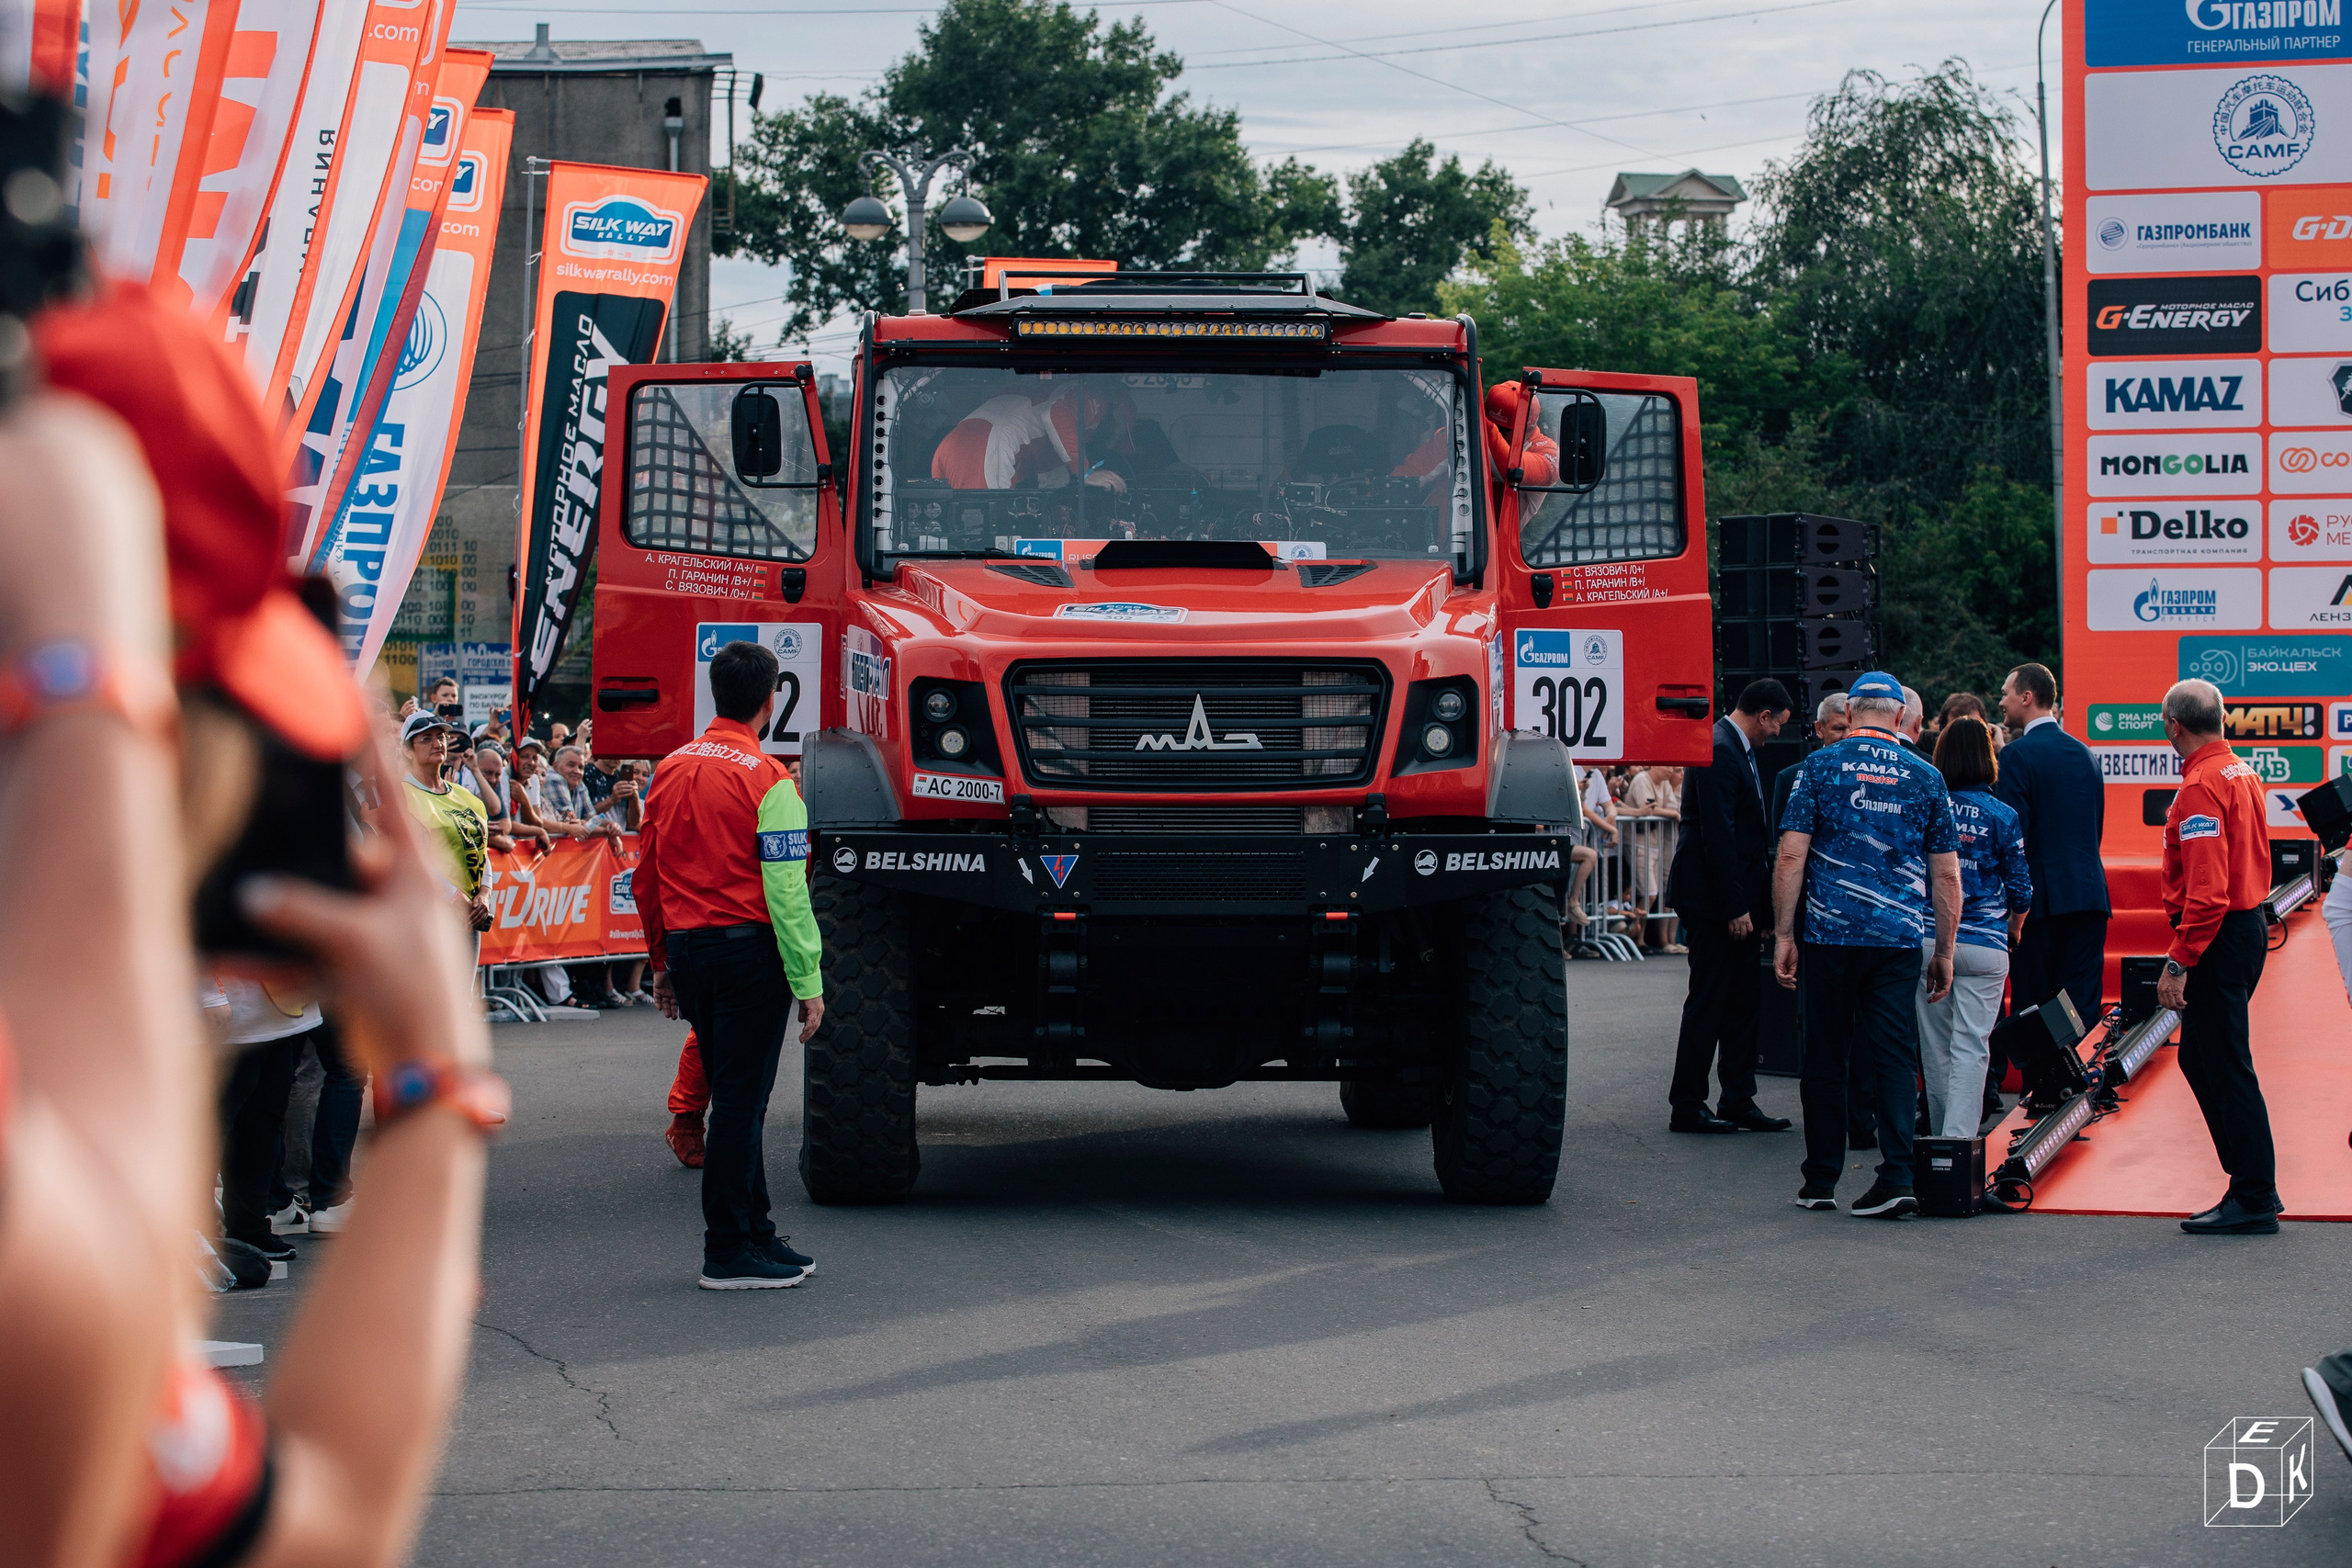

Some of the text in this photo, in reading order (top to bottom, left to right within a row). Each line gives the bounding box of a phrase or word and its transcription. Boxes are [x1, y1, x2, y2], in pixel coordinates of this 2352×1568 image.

[2232, 0, 2341, 29] ГАЗПРОМ
[2188, 35, 2341, 53] ГЕНЕРАЛЬНЫЙ ПАРТНЕР
[2228, 143, 2301, 160] CAMF
[573, 216, 672, 237] SILK WAY
[2137, 222, 2251, 241] ГАЗПРОМБАНК
[597, 231, 646, 243] RALLY
[556, 263, 673, 287] silkwayrally.com
[2295, 279, 2350, 302] Сиб
[2160, 301, 2255, 310] МОТОРНОЕ МАСЛО
[2105, 376, 2244, 413] KAMAZ
[2100, 454, 2249, 476] MONGOLIA
[2129, 510, 2249, 539] Delko
[645, 553, 655, 563] А.
[658, 554, 732, 571] КРАГЕЛЬСКИЙ
[668, 569, 678, 580] П.
[681, 570, 729, 585] ГАРАНИН
[1573, 567, 1583, 578] С.
[1585, 564, 1628, 577] ВЯЗОВИЧ
[665, 580, 675, 591] С.
[678, 582, 729, 597] ВЯЗОВИЧ
[1575, 581, 1585, 591] П.
[1586, 578, 1628, 591] ГАРАНИН
[1576, 592, 1586, 603] А.
[1587, 587, 1651, 602] КРАГЕЛЬСКИЙ
[2161, 590, 2216, 604] ГАЗПРОМ
[2162, 606, 2216, 615] ДОБЫЧА
[1534, 652, 1568, 664] GAZPROM
[2247, 645, 2342, 658] БАЙКАЛЬСК
[2247, 660, 2318, 673] ЭКО.ЦЕХ
[1532, 676, 1608, 747] 302
[2119, 713, 2141, 721] РИА
[2118, 721, 2154, 729] СПОРТ
[2223, 706, 2315, 736] МАТЧ!
[1871, 747, 1898, 761] VTB
[1841, 761, 1912, 779] KAMAZ
[1856, 773, 1899, 785] master
[927, 778, 1001, 800] AC 2000-7
[1865, 799, 1903, 815] ГАЗПРОМ
[1955, 804, 1980, 818] VTB
[1955, 822, 1989, 837] MAZ
[2182, 823, 2197, 831] SILK
[865, 852, 987, 873] BELSHINA
[1445, 851, 1560, 872] BELSHINA
